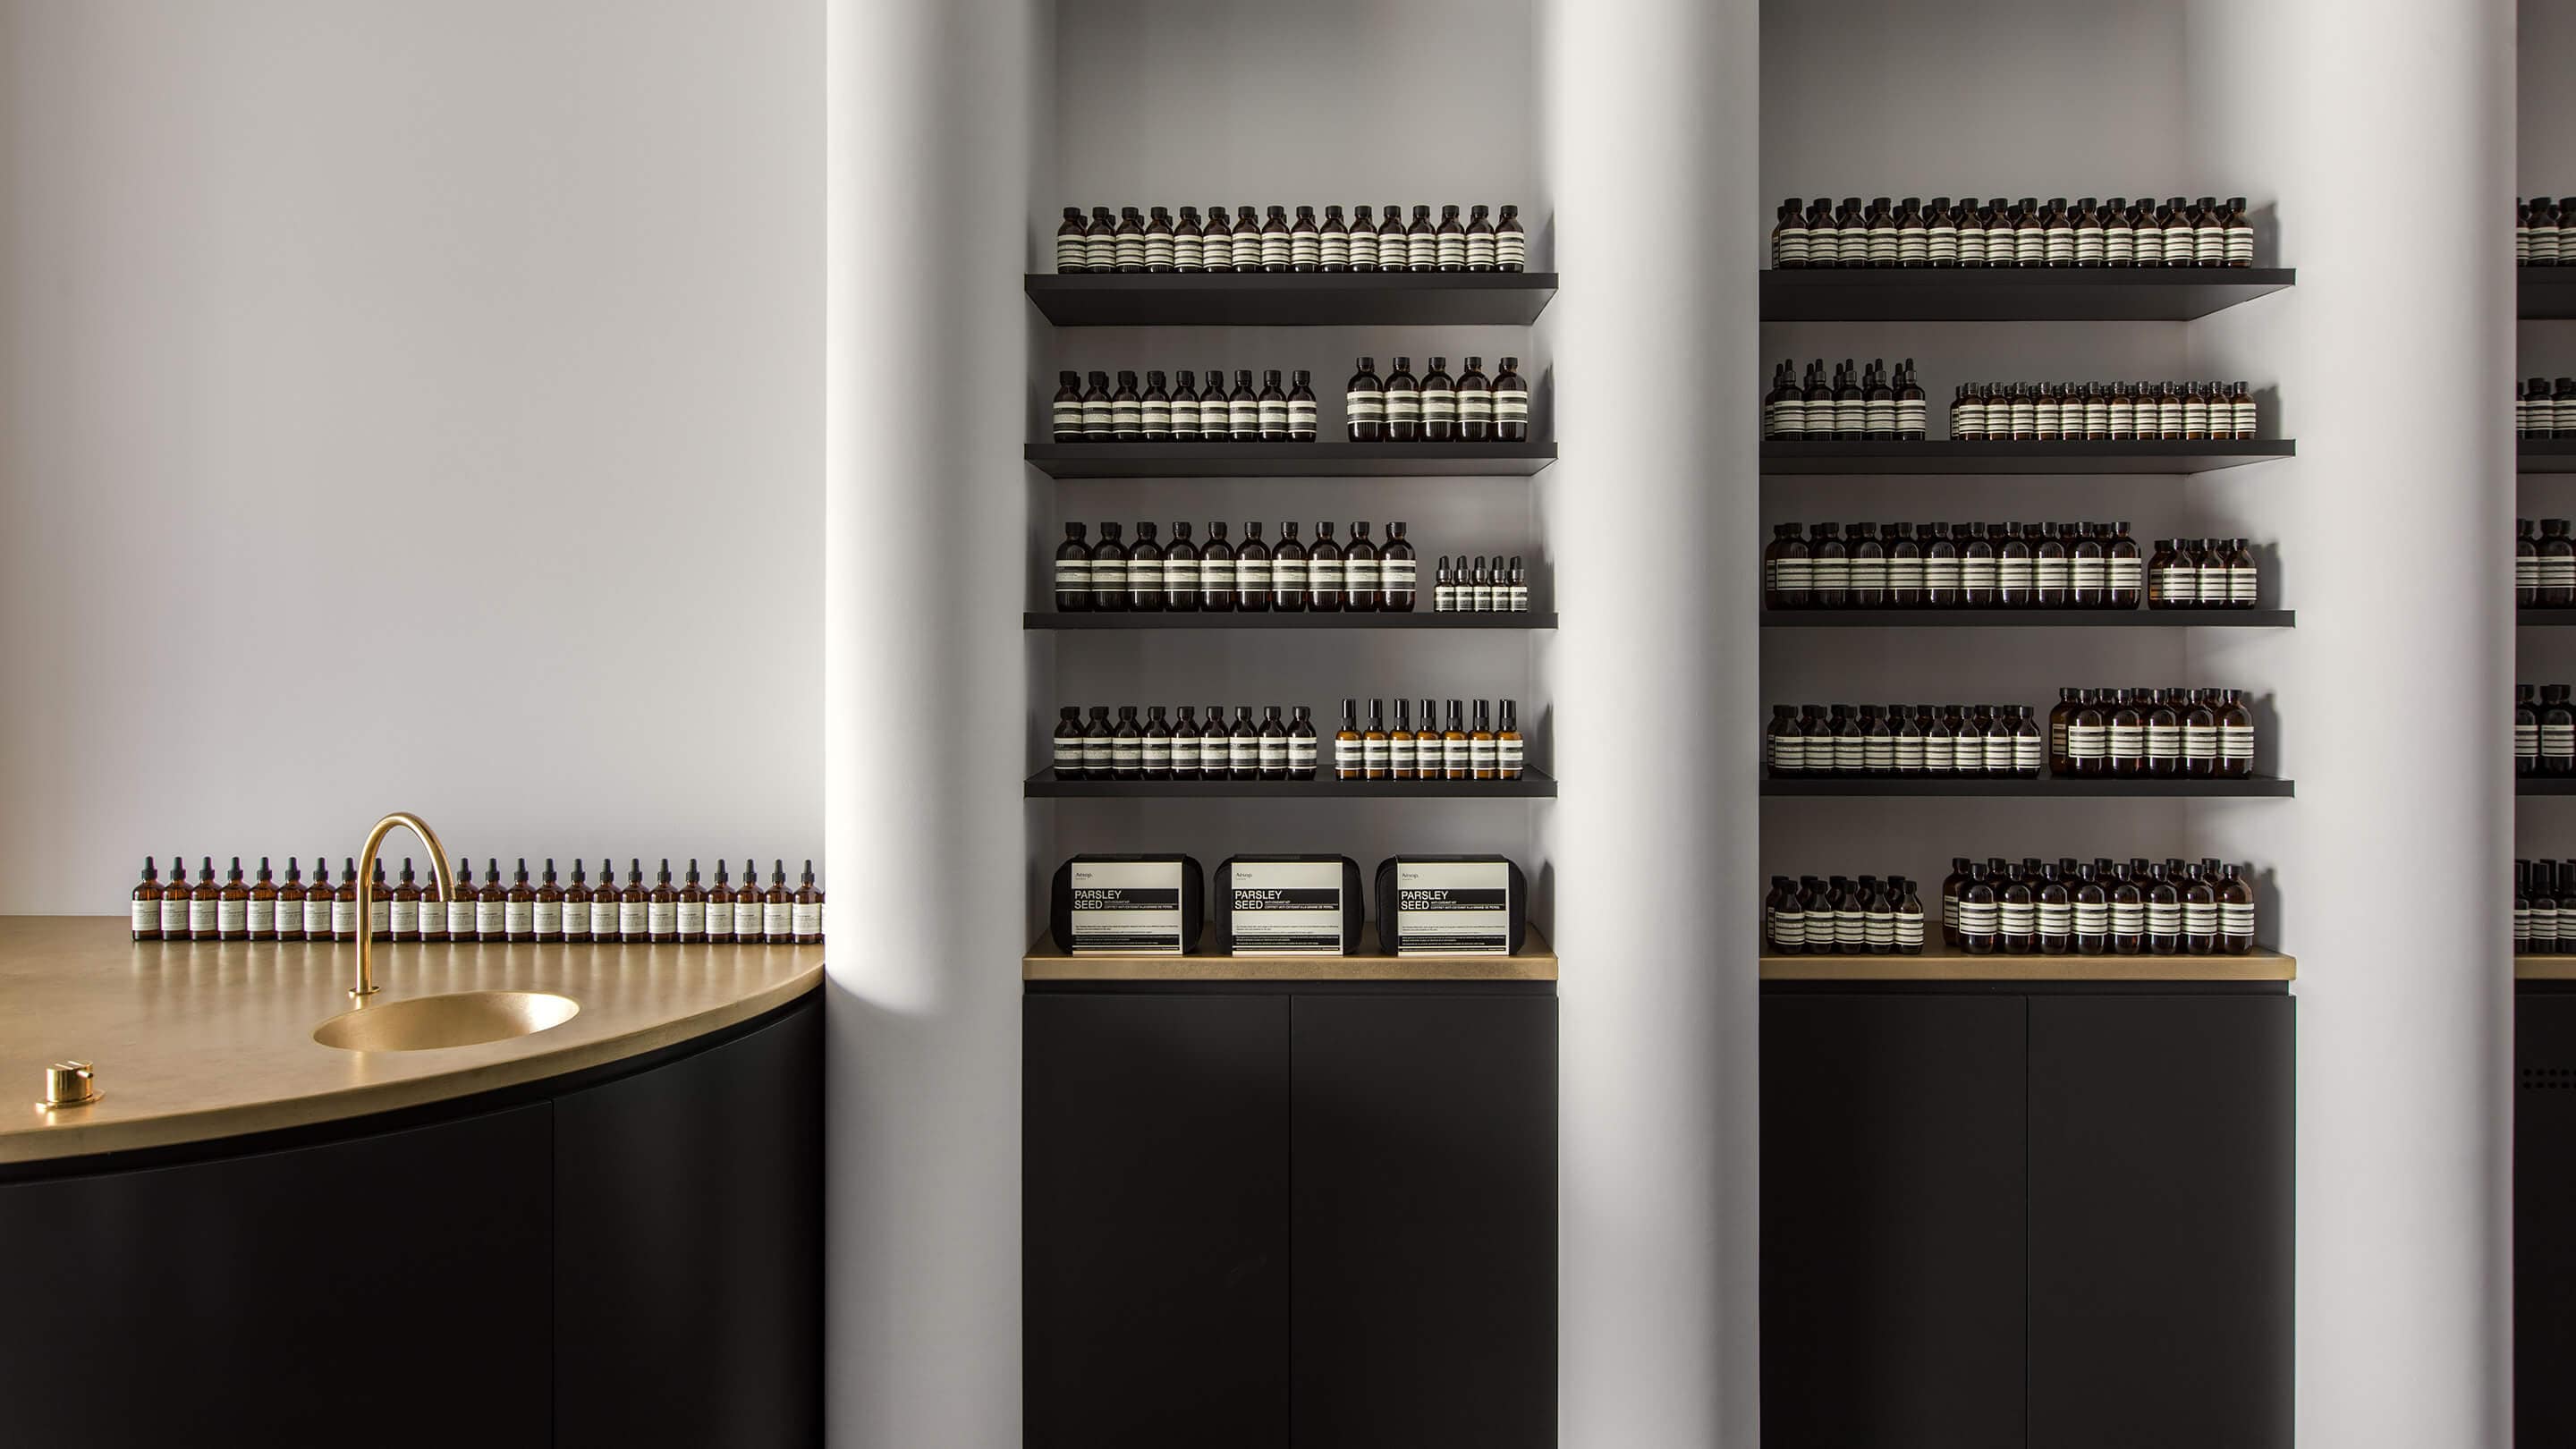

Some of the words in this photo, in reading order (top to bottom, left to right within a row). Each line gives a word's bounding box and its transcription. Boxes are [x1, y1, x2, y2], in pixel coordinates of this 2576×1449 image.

[1074, 889, 1122, 900] PARSLEY
[1234, 890, 1283, 900] PARSLEY
[1401, 890, 1449, 901] PARSLEY
[1074, 900, 1103, 910] SEED
[1234, 900, 1264, 910] SEED
[1401, 901, 1430, 911] SEED
